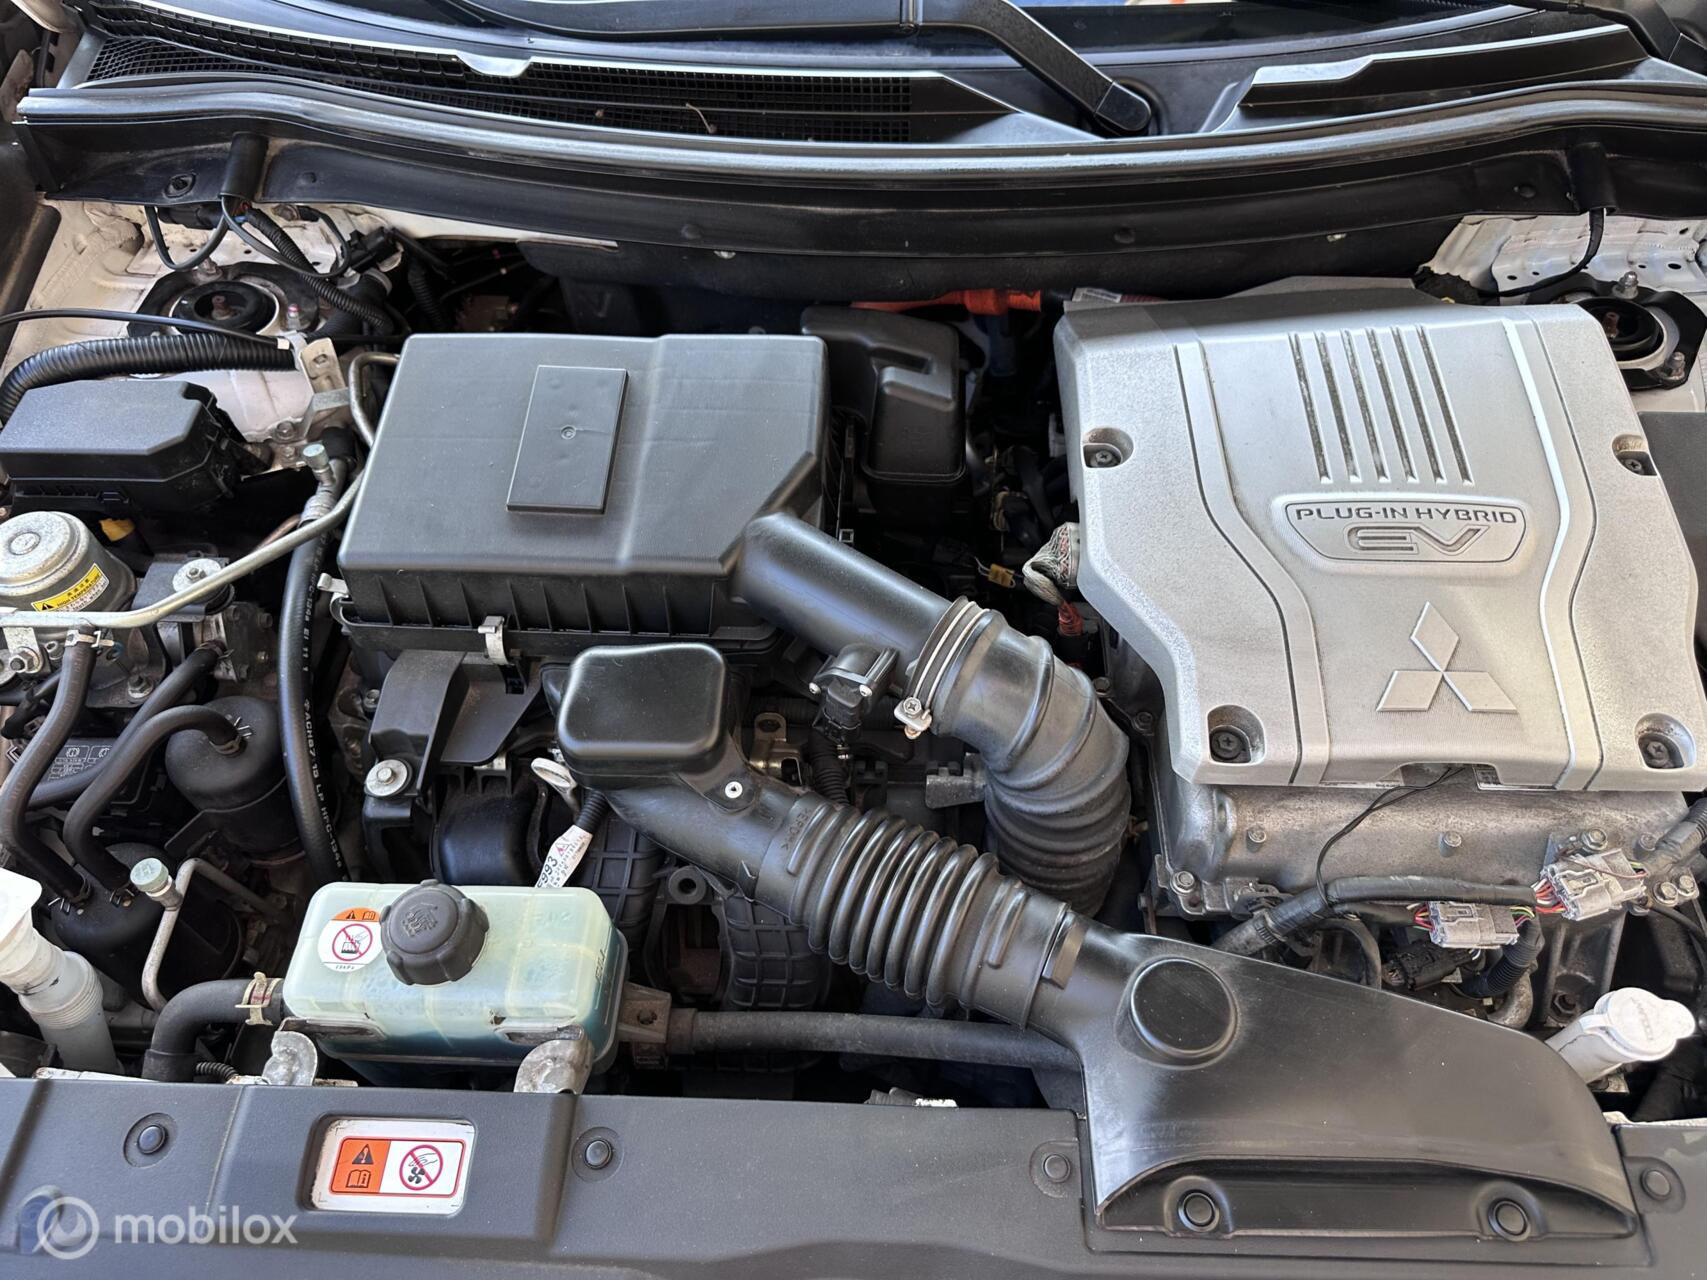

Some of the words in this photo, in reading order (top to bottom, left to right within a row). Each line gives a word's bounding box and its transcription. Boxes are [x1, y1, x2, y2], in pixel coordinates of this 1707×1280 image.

[1295, 506, 1409, 520] PLUG-IN
[1414, 507, 1518, 524] HYBRID
[1345, 524, 1487, 555] EV
